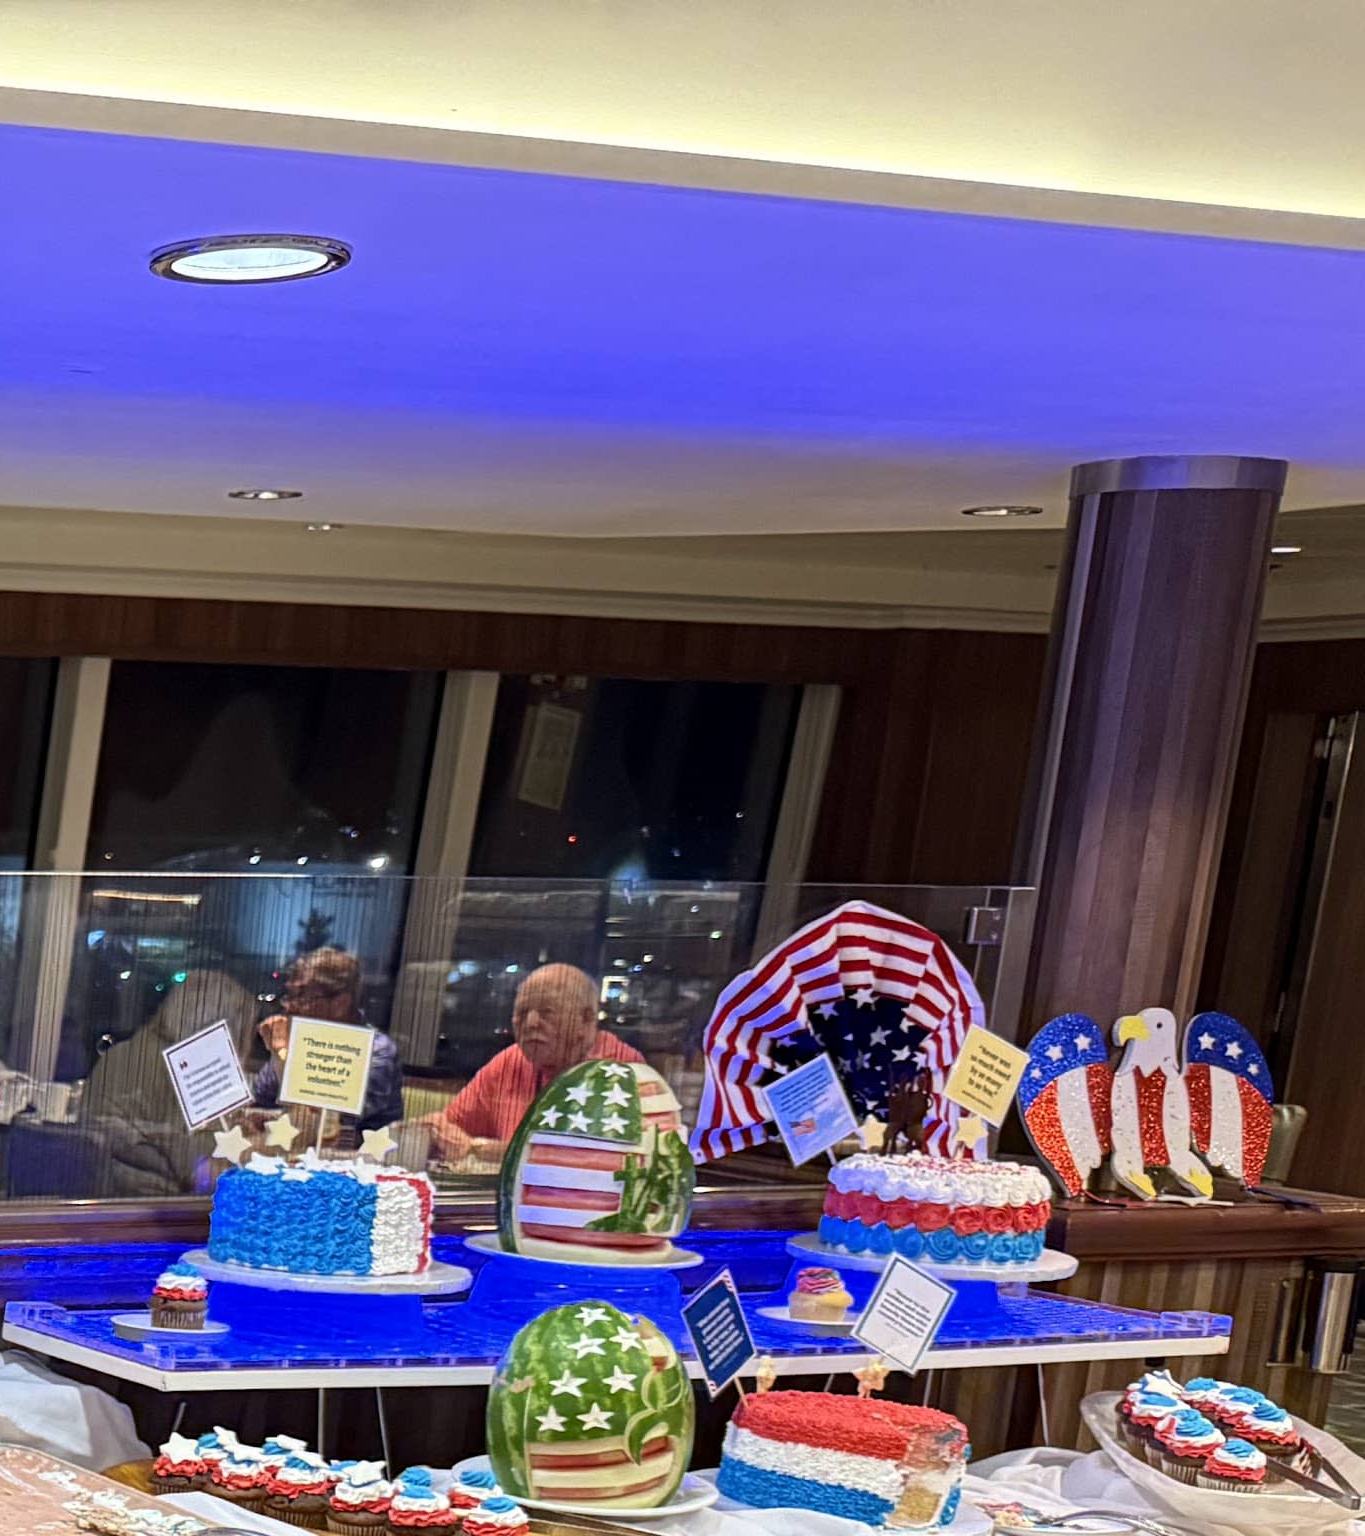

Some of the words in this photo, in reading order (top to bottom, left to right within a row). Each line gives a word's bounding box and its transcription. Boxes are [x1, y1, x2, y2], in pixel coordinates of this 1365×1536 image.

[334, 1044, 361, 1056] nothing
[307, 1052, 335, 1062] stronger
[336, 1055, 352, 1064] than
[306, 1062, 317, 1071] the
[319, 1064, 336, 1074] heart
